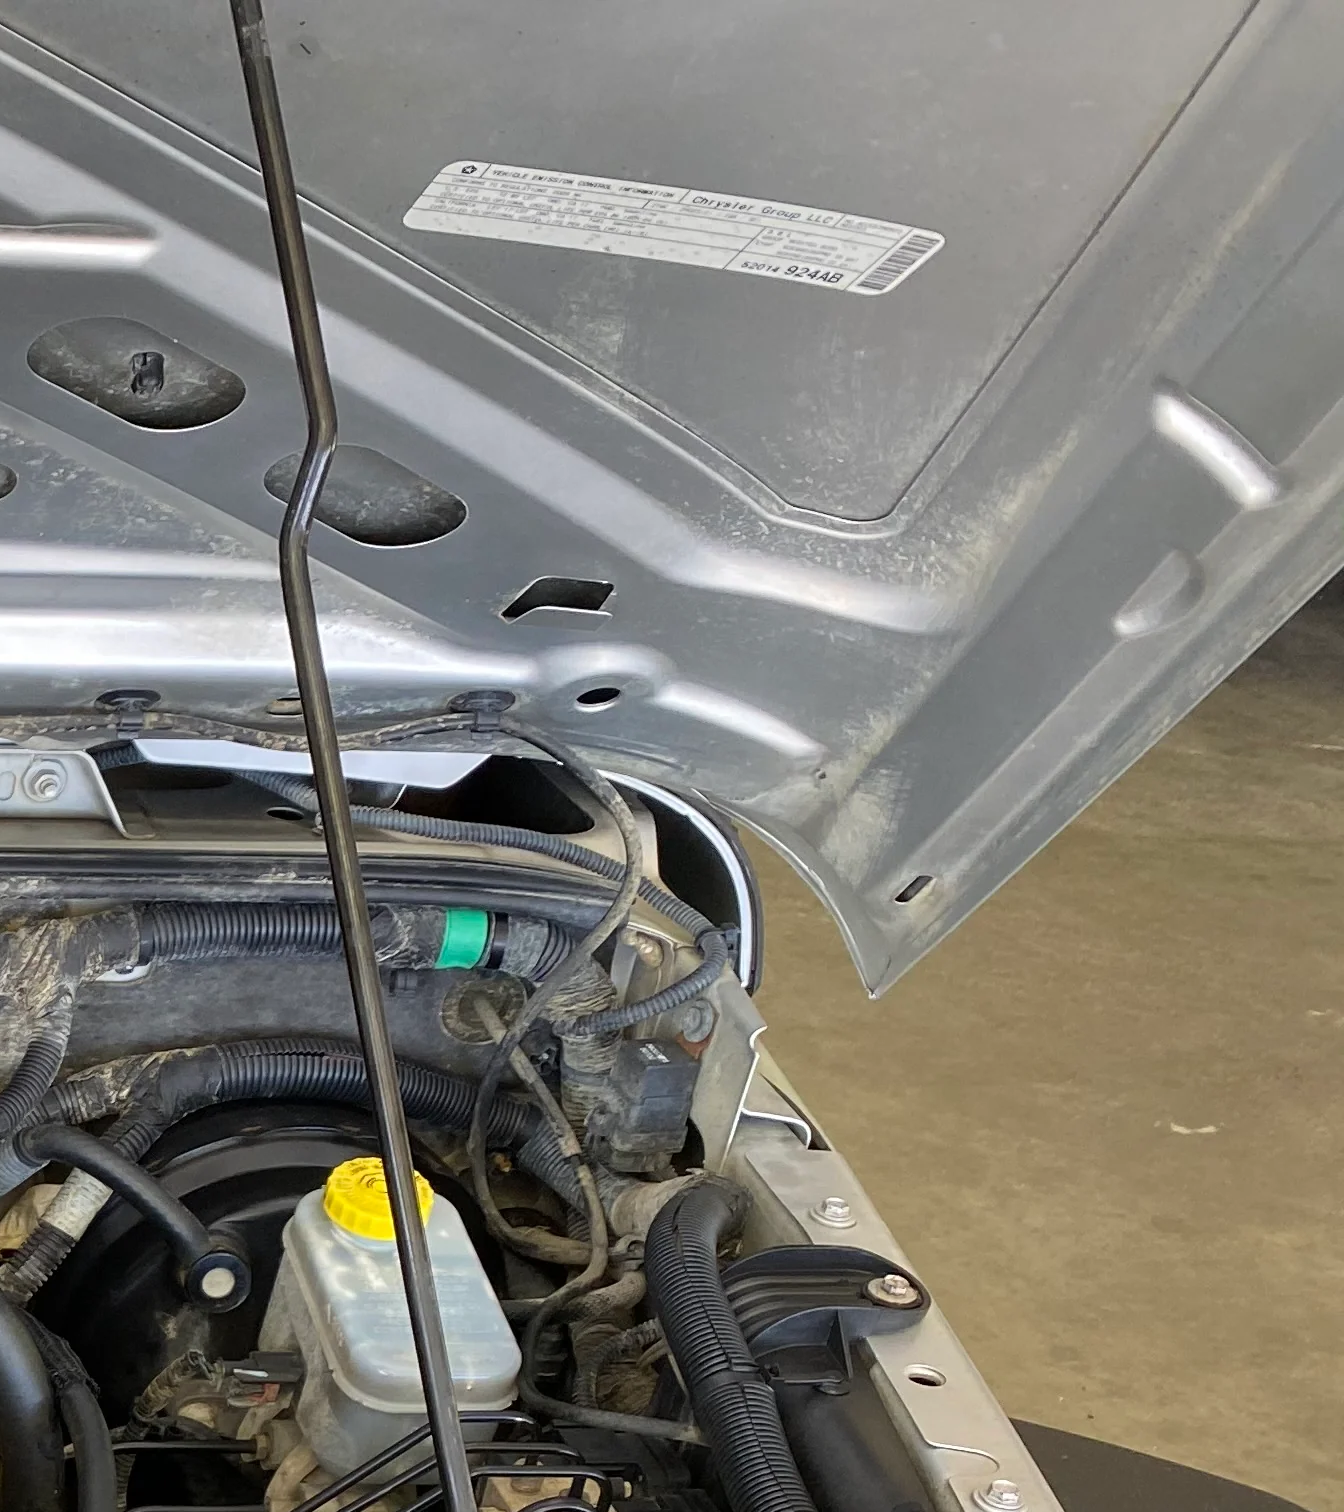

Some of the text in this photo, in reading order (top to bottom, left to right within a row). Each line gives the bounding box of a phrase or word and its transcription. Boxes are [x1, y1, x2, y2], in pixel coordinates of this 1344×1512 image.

[692, 195, 755, 212] Chrysler
[762, 206, 801, 221] Group
[806, 213, 834, 225] LLC
[740, 261, 844, 284] 52014 924AB
